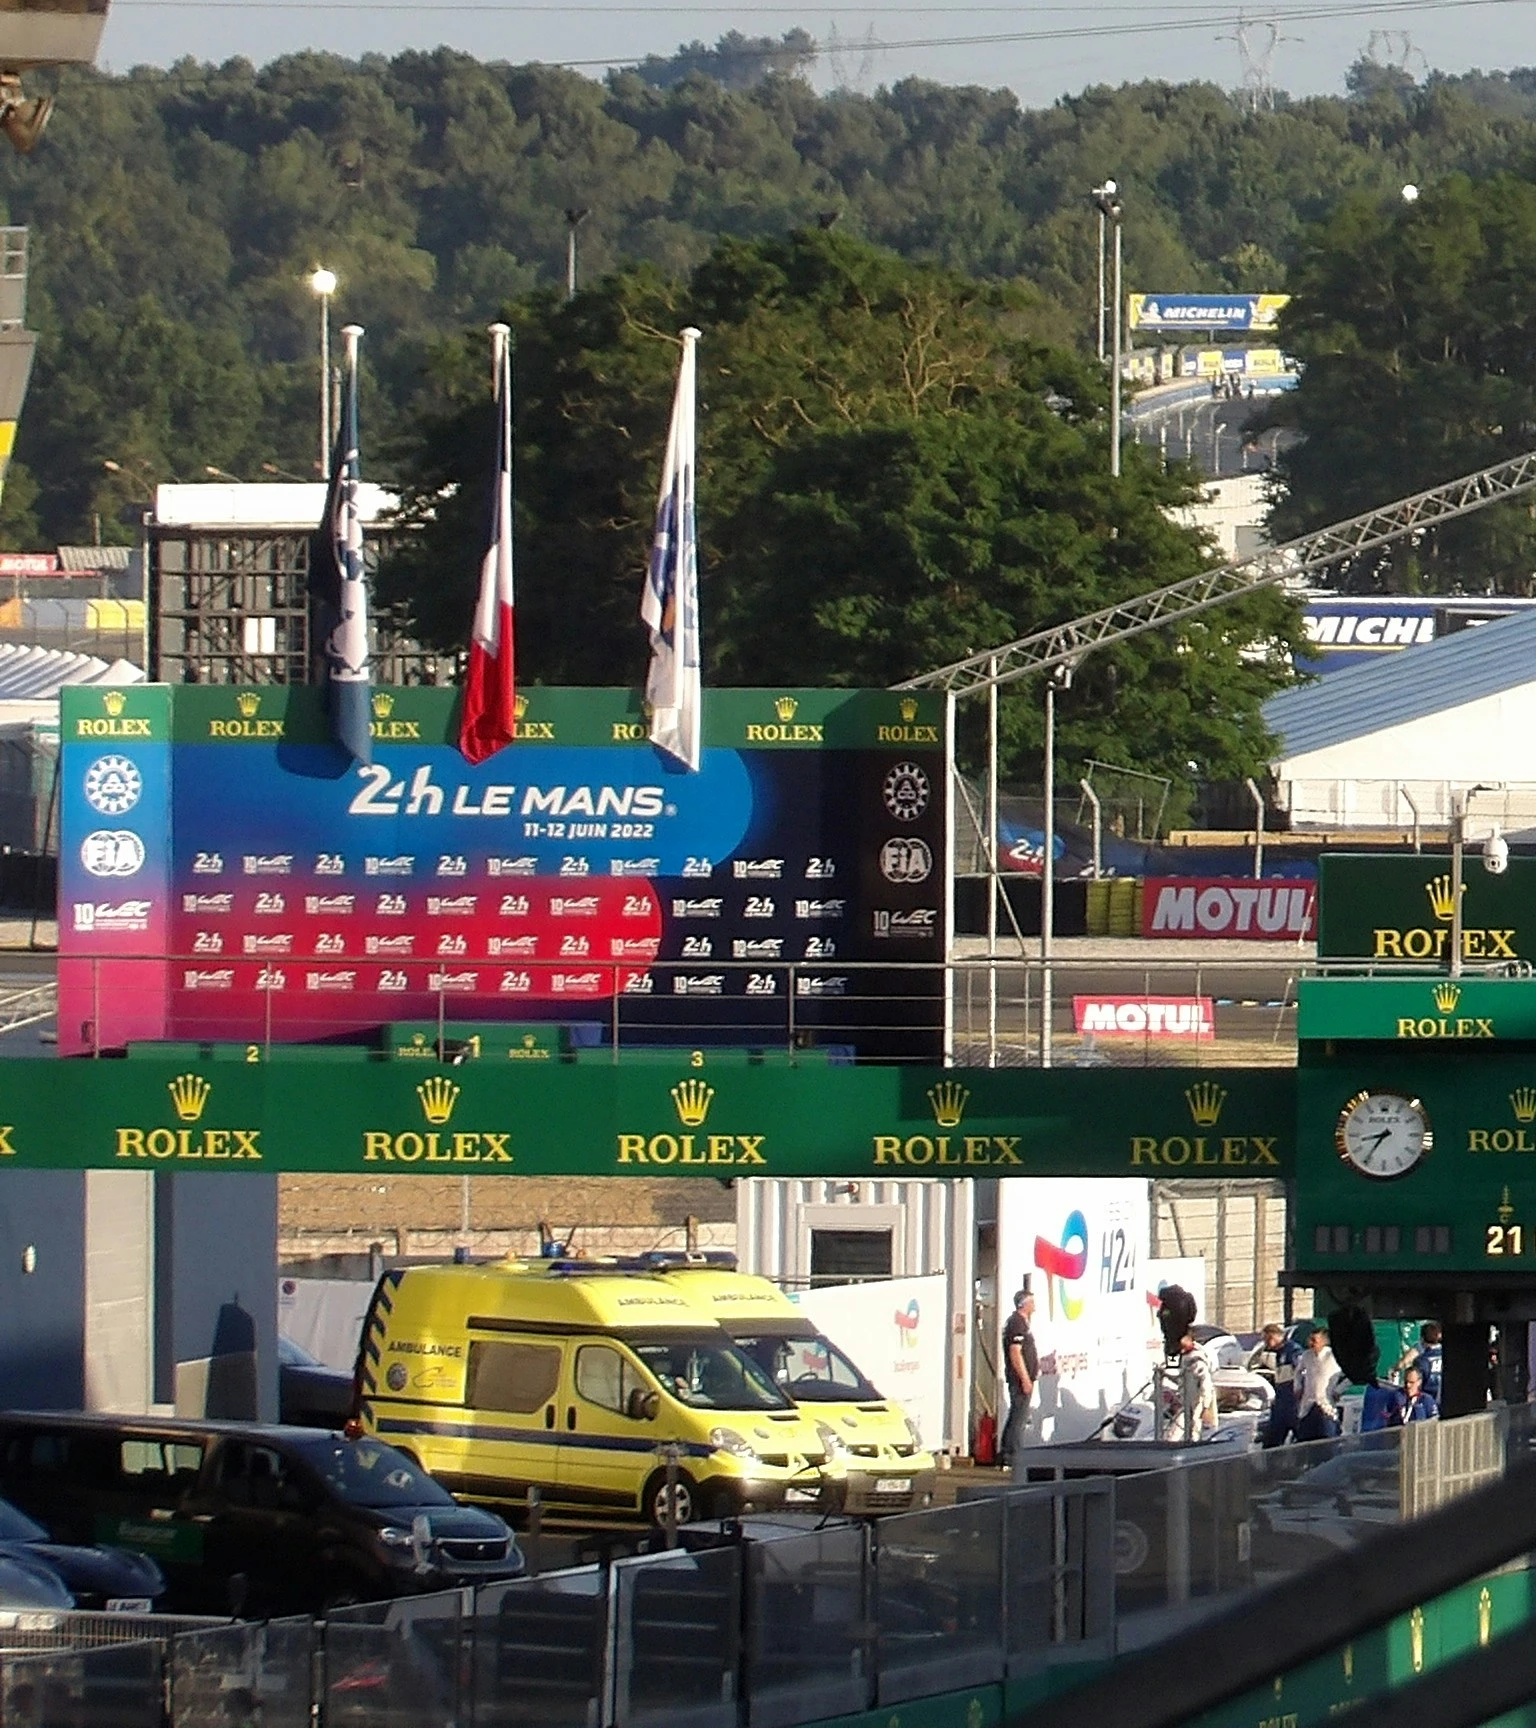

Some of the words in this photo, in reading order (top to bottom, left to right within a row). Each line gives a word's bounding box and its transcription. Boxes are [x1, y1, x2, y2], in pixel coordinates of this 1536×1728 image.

[1162, 306, 1246, 320] MICHELIN
[77, 719, 151, 736] ROLEX
[209, 720, 285, 737] ROLEX
[746, 724, 824, 741] ROLEX
[877, 725, 939, 743] ROLEX
[452, 785, 516, 816] LE
[520, 786, 665, 817] MANS
[523, 823, 565, 838] 11-12
[567, 823, 608, 839] JUIN
[610, 823, 654, 839] 2022
[73, 903, 95, 924] 10
[95, 900, 152, 918] WEC
[873, 910, 890, 930] 10
[890, 909, 938, 924] WEC
[1151, 886, 1313, 933] MOTUL
[1082, 1003, 1210, 1034] MOTUL
[1397, 1019, 1495, 1039] ROLEX
[246, 1045, 259, 1063] 2
[469, 1035, 481, 1059] 1
[690, 1051, 704, 1067] 3
[115, 1128, 264, 1160] ROLEX
[362, 1131, 514, 1163] ROLEX
[616, 1134, 767, 1164] ROLEX
[872, 1135, 1024, 1165] ROLEX
[1130, 1136, 1281, 1166] ROLEX
[1486, 1225, 1523, 1255] 21
[387, 1339, 463, 1358] AMBULANCE
